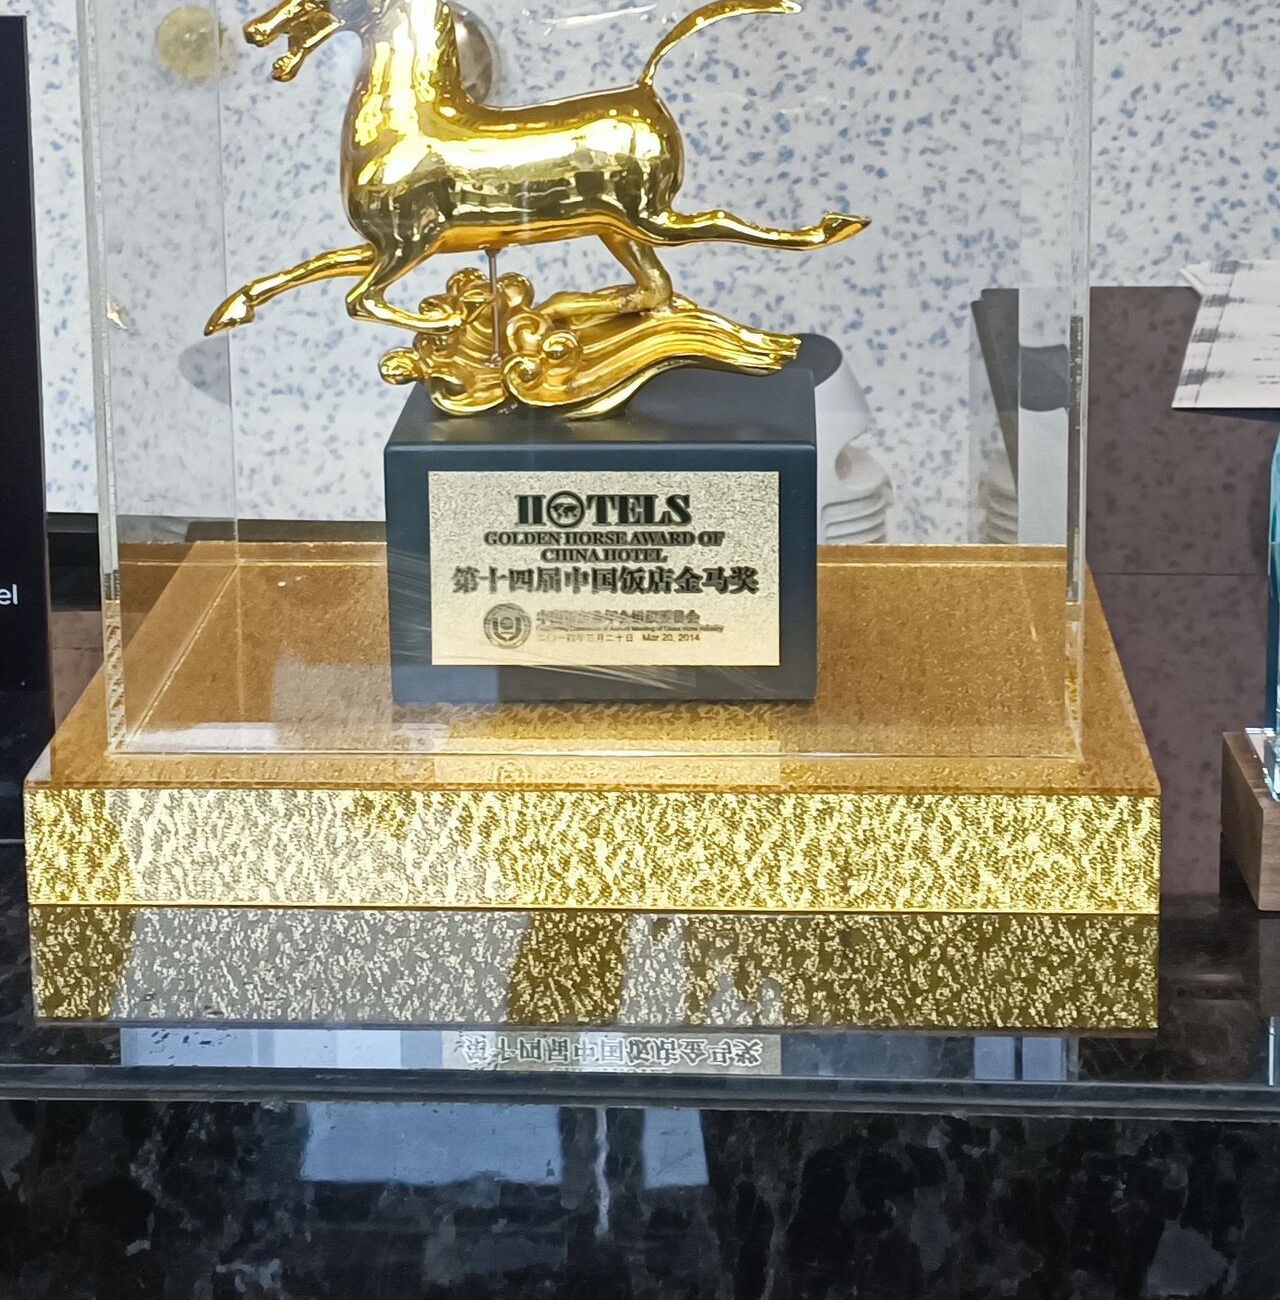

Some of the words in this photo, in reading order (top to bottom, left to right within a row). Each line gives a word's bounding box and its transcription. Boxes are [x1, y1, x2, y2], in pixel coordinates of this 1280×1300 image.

[513, 490, 692, 528] HOTELS
[483, 531, 562, 547] GOLDEN
[564, 531, 628, 547] HORSE
[629, 531, 696, 547] AWARD
[697, 531, 726, 547] OF
[540, 548, 601, 563] CHINA
[603, 548, 668, 563] HOTEL
[451, 566, 760, 595] 第十四届中国饭店金马奖
[678, 633, 701, 643] 2014
